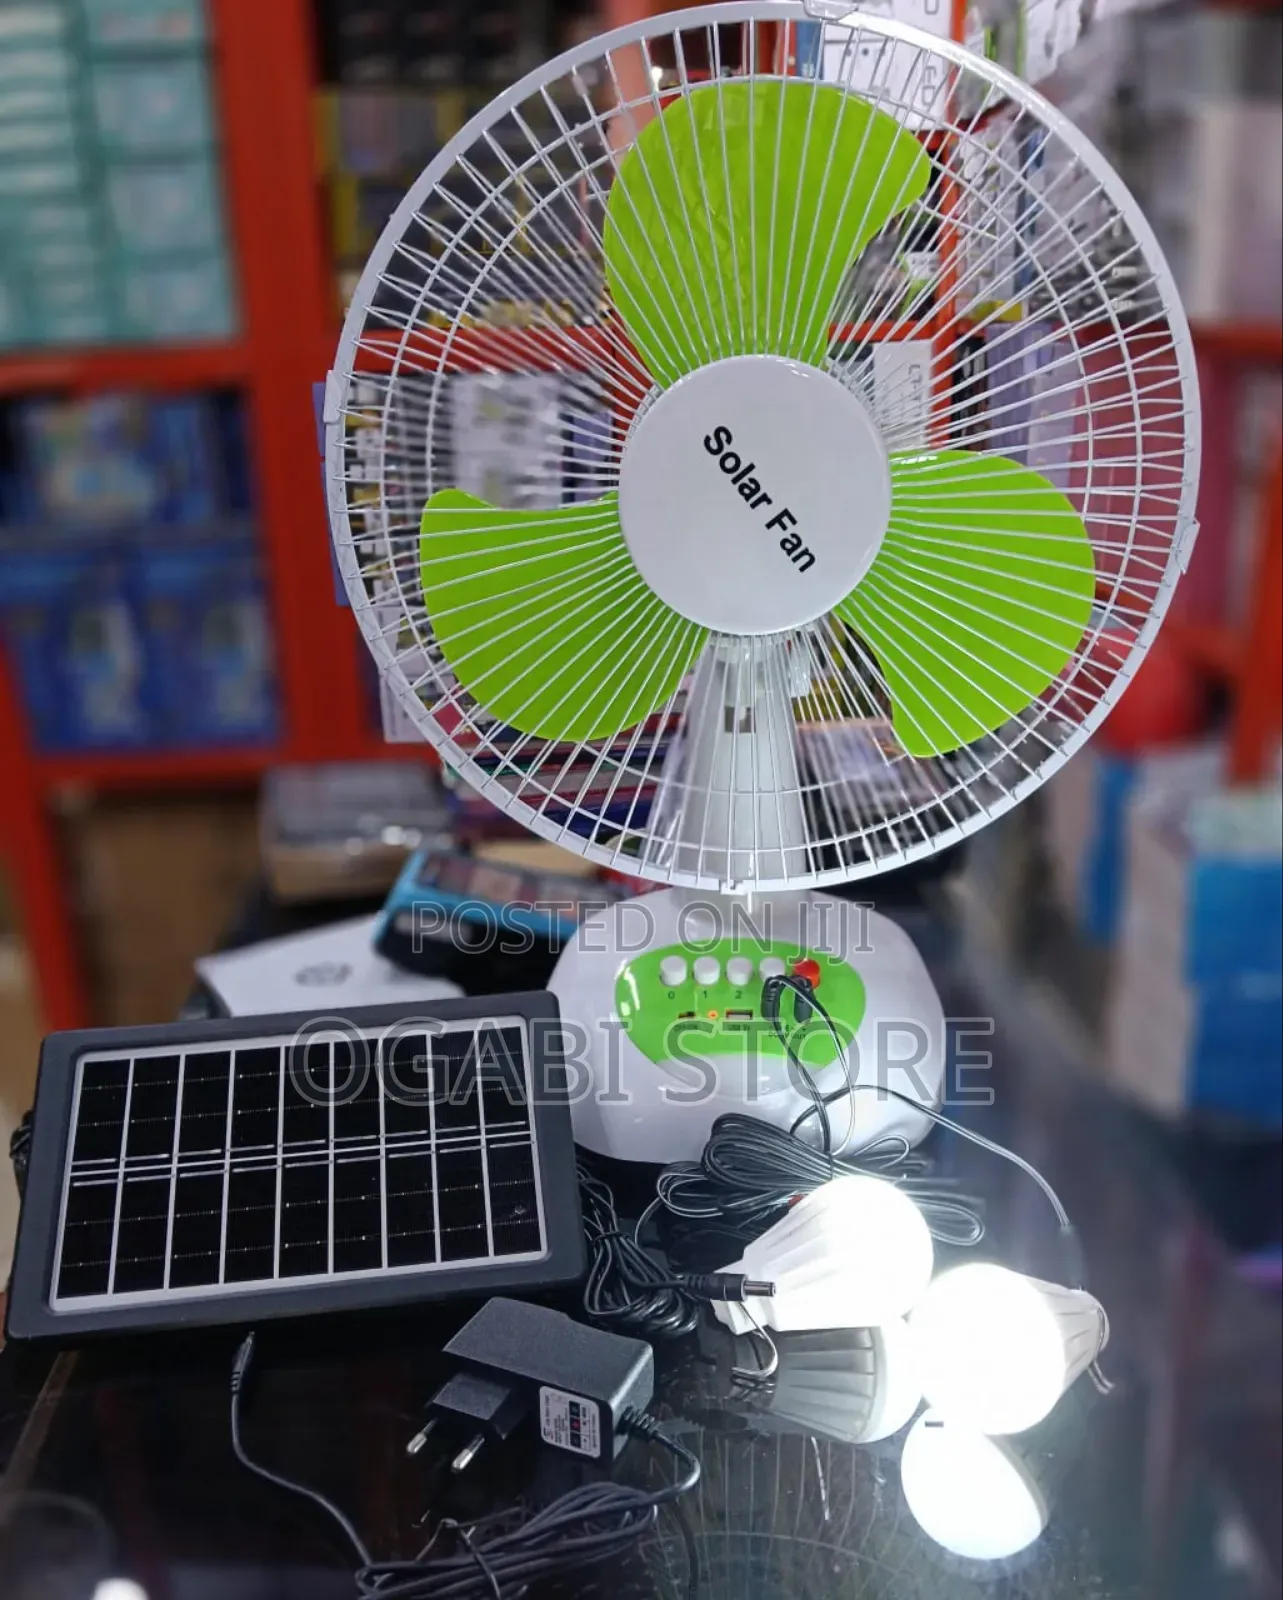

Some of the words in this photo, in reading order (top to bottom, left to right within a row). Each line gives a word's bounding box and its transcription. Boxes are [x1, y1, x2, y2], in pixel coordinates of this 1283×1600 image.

[703, 425, 773, 510] Solar
[765, 507, 816, 573] Fan
[734, 989, 743, 1000] 2
